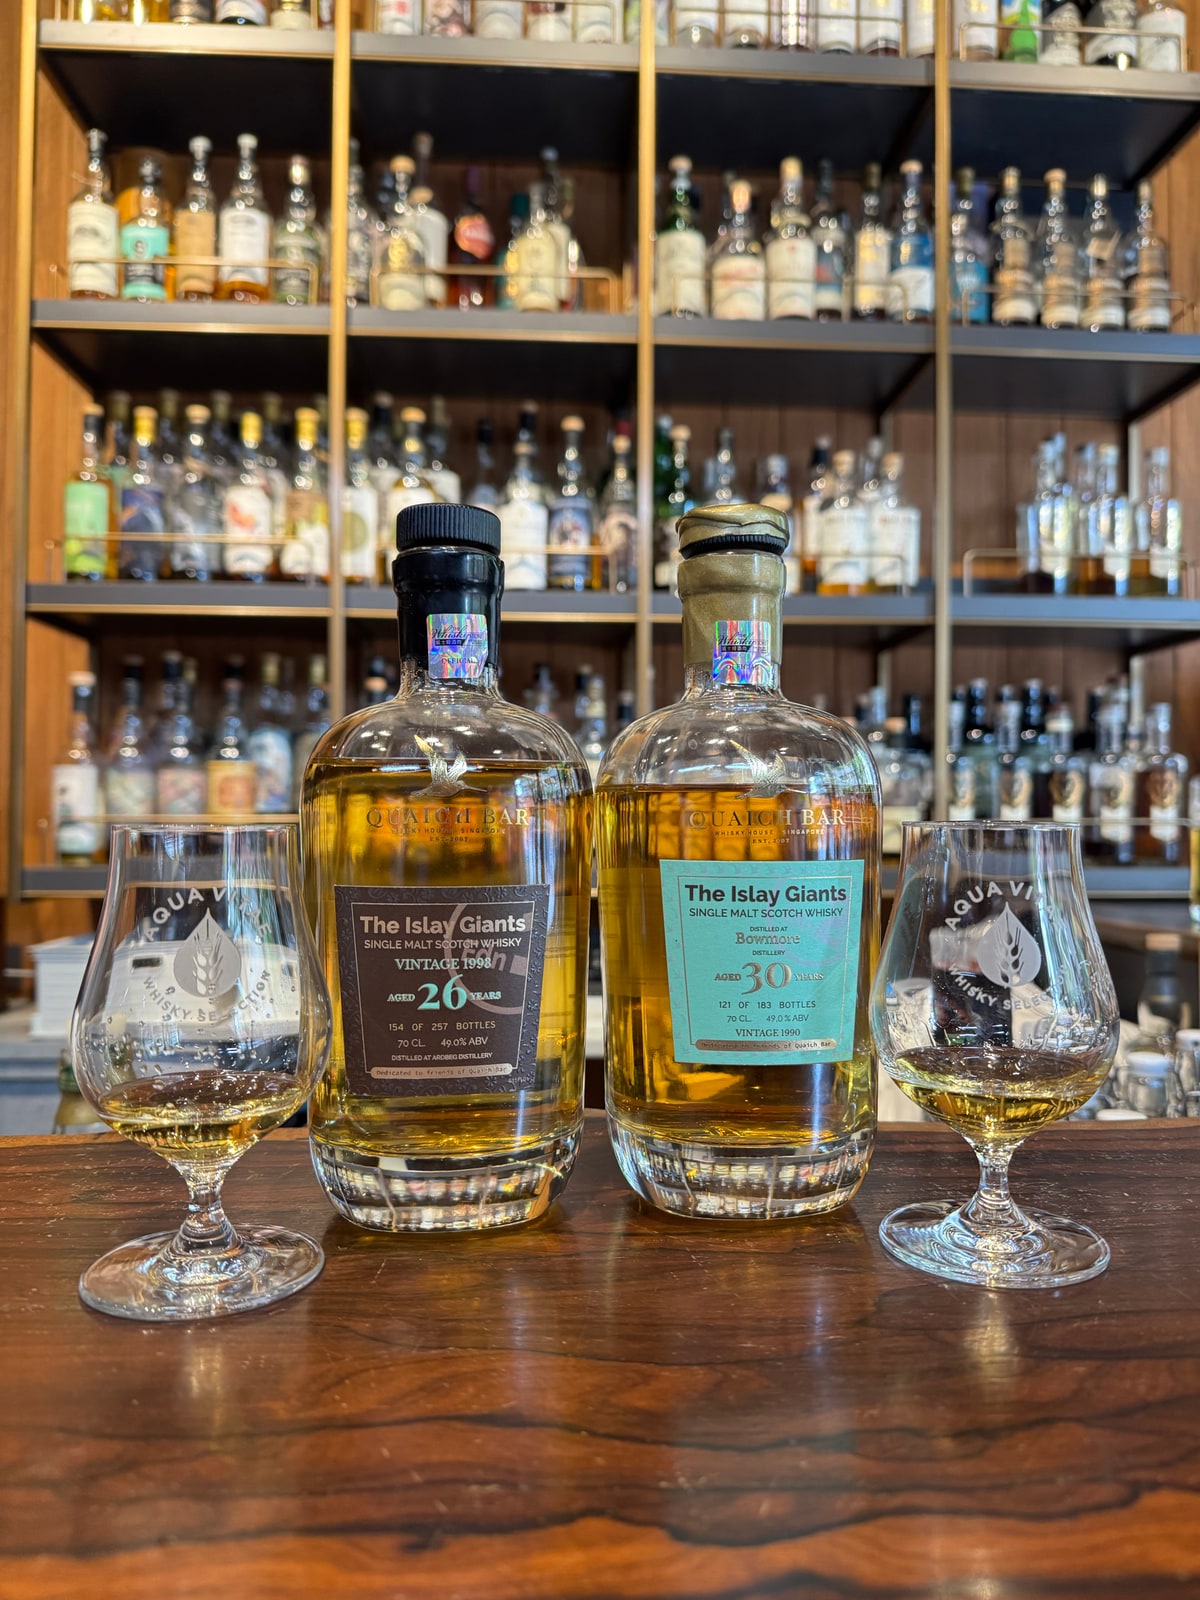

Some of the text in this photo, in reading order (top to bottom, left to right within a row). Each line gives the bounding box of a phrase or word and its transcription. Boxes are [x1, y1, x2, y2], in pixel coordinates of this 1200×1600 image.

[366, 807, 530, 828] QUAICH BAR
[688, 809, 846, 829] QUAICH BAR
[684, 884, 847, 908] The Islay Giants
[689, 907, 844, 918] SINGLE MALT SCOTCH WHISKY
[944, 880, 1004, 932] AQUA
[143, 886, 272, 942] AQUA VITAE
[359, 914, 527, 938] The Islay Giants
[364, 937, 523, 950] SINGLE MALT SCOTCH WHISKY
[734, 932, 801, 945] Bowmore
[394, 957, 493, 971] VINTAGE 1998
[714, 961, 825, 995] AGED 30 YEARS
[948, 963, 999, 1007] WHISKY
[143, 976, 192, 1020] WHISKY
[386, 973, 502, 1011] AGED 26 YEARS
[718, 1000, 817, 1009] 121 OF 183 BOTTLES
[726, 1015, 738, 1023] 70
[791, 1014, 810, 1022] ABV
[388, 1020, 497, 1032] 154 OF 257 BOTTLES
[735, 1028, 801, 1037] VINTAGE 1990
[397, 1039, 409, 1049] 70
[440, 1036, 489, 1049] 49.0% ABV
[794, 1041, 818, 1049] Quaich
[423, 1053, 432, 1061] AT
[432, 1053, 458, 1061] ARDBEG
[458, 1051, 493, 1060] DISTILLERY
